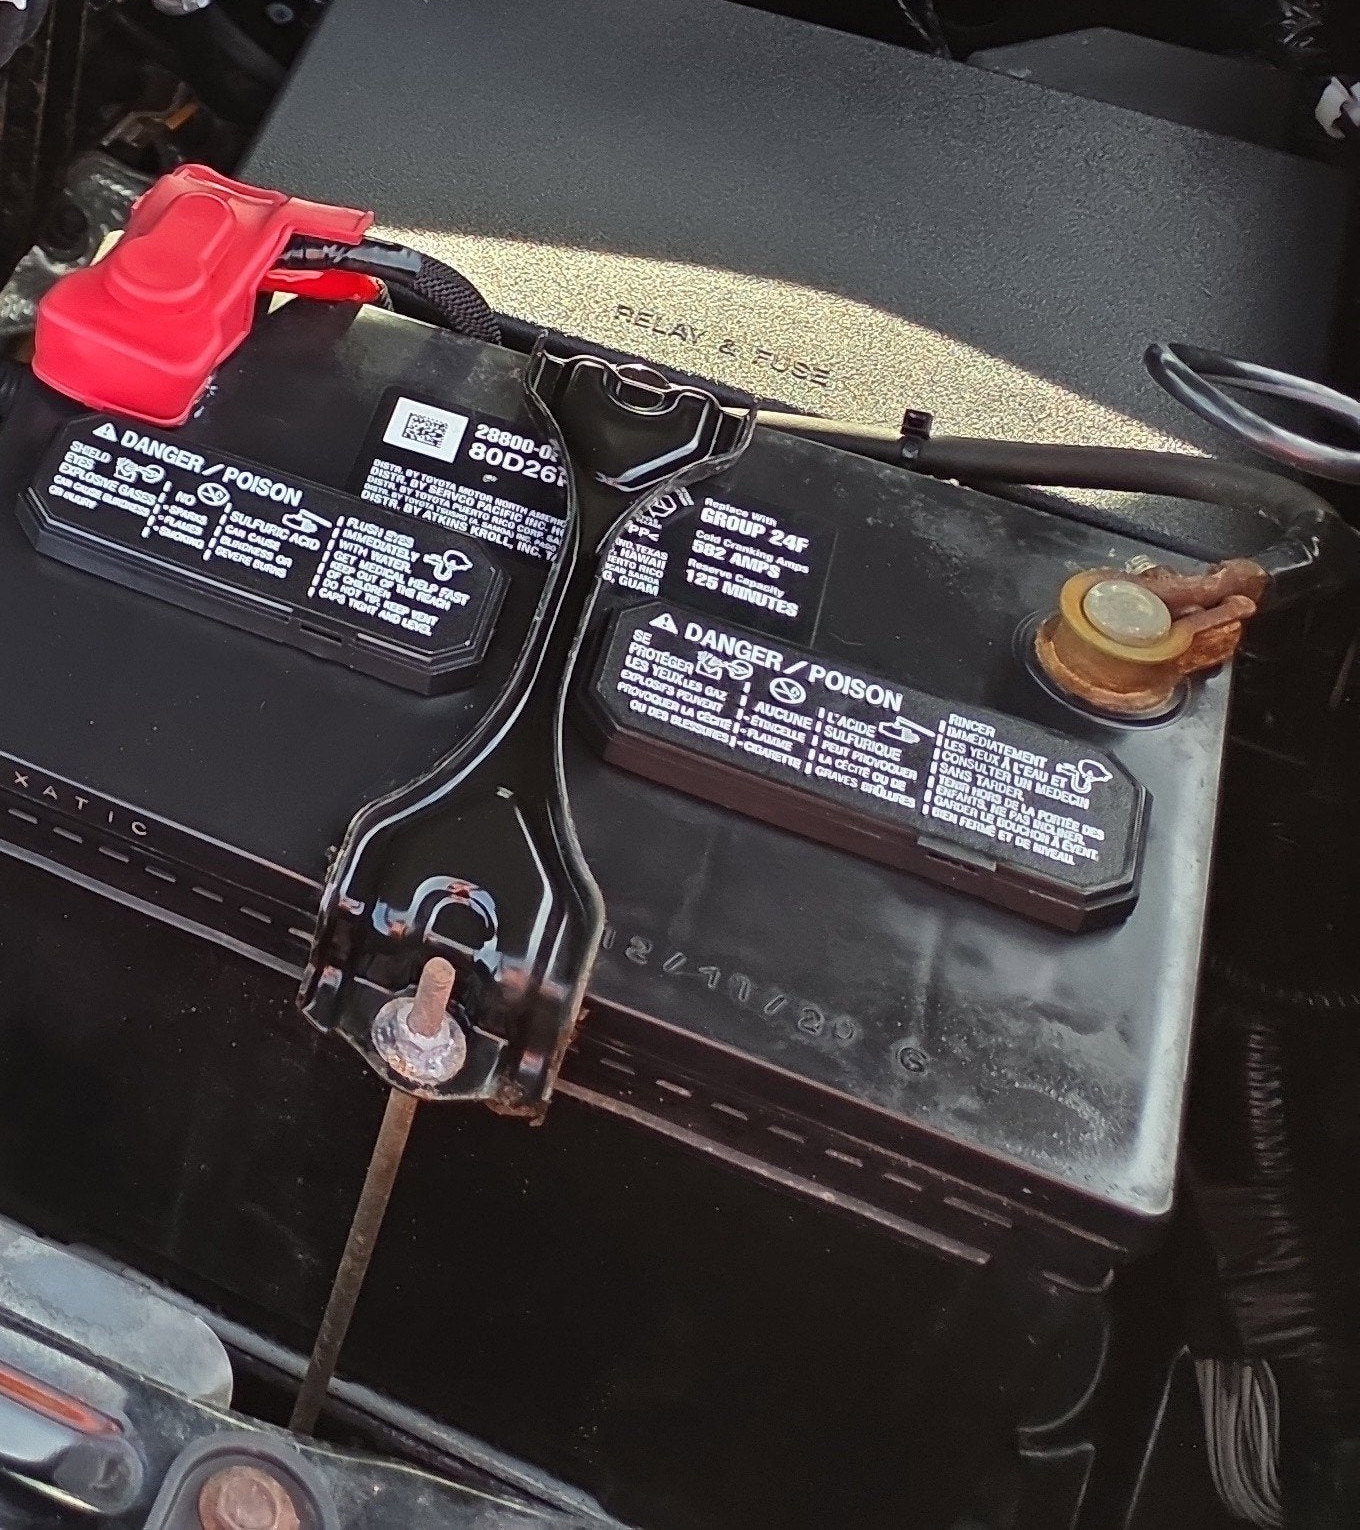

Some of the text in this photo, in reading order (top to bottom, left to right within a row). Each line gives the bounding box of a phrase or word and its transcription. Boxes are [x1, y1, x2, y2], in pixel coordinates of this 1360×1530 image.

[614, 302, 834, 388] RELAY & FUSE
[63, 451, 96, 471] EYES
[69, 440, 112, 464] SHIELD
[120, 429, 205, 474] DANGER
[221, 466, 304, 507] POISON
[58, 461, 158, 507] EXPLOSIVE GASES
[174, 490, 197, 507] NO
[369, 465, 408, 486] DISTR.
[409, 478, 428, 491] BY
[427, 484, 476, 507] SERVCO
[476, 500, 524, 523] PACIFIC
[524, 516, 548, 532] INC.
[405, 468, 421, 479] BY
[420, 473, 457, 493] TOYOTA
[457, 485, 494, 504] MOTOR
[494, 497, 529, 515] NORTH
[528, 509, 569, 529] AMERIC
[398, 484, 415, 496] BY
[414, 489, 451, 509] TOYOTA
[451, 502, 491, 521] PUERTO
[490, 515, 516, 530] RICO
[404, 494, 435, 511] TOYOTA
[704, 497, 778, 528] Replace With
[158, 525, 205, 550] SMOKING
[224, 524, 282, 552] CAN CAUSE
[229, 510, 321, 551] SULFURIC ACID
[345, 516, 415, 549] FLUSH EYES
[360, 489, 401, 511] DISTR.
[402, 502, 423, 516] BY
[421, 509, 469, 532] ATKINS
[516, 540, 542, 558] INC.
[700, 507, 767, 539] GROUP
[768, 528, 810, 553] 24F
[214, 545, 288, 579] SEVERE BURNS
[219, 534, 293, 569] BLINDNESS OR
[338, 538, 369, 558] WITH
[341, 528, 421, 563] IMMEDIATELY
[619, 547, 667, 571] HAWAII
[635, 543, 669, 561] TEXAS
[691, 538, 781, 579] 582 AMPS
[695, 529, 810, 574] Cold Cranking Amps
[325, 569, 392, 600] OF CHILDREN
[329, 560, 452, 612] KEEP OUT OF THE REACH
[333, 550, 471, 607] GET MEDICAL HELP FAST
[618, 574, 660, 597] GUAM
[638, 563, 664, 579] RICO
[687, 557, 786, 599] Reserve Capacity
[318, 587, 402, 625] CAPS TIGHT AND
[321, 577, 440, 627] DO NOT KEEP VENT
[685, 568, 799, 618] 125 MINUTES
[632, 629, 653, 646] SE
[624, 654, 685, 686] LES YEUX
[628, 641, 695, 676] PROTÉGER
[683, 622, 784, 672] DANGER
[807, 663, 904, 713] POISON
[616, 681, 695, 718] PROVOQUER LA
[620, 668, 724, 714] EXPLOSIFS PEUVENT
[682, 678, 729, 702] LES GAZ
[629, 699, 648, 713] OU
[646, 705, 670, 722] DES
[752, 701, 814, 731] AUCUNE
[826, 711, 878, 739] L'ACIDE
[948, 713, 996, 739] RINCER
[743, 740, 803, 771] CIGARETTE
[746, 727, 794, 752] FLAMME
[823, 724, 903, 762] SULFURIQUE
[814, 765, 859, 788] GRAVES
[817, 752, 833, 766] LA
[871, 771, 890, 786] OU
[889, 777, 907, 793] DE
[820, 739, 918, 781] PEUT PROVOQUER
[938, 761, 973, 783] SANS
[941, 750, 1012, 785] CONSULTER
[1013, 774, 1033, 792] UN
[943, 737, 1069, 789] LES YEUX L'EAU ET
[933, 794, 1051, 845] GARDER LE BOUCHON
[989, 803, 1031, 826] NE PAS
[1003, 797, 1020, 812] DE
[1020, 802, 1036, 818] LA
[1081, 823, 1105, 841] DES
[997, 829, 1014, 843] ET
[1014, 835, 1032, 851] DE
